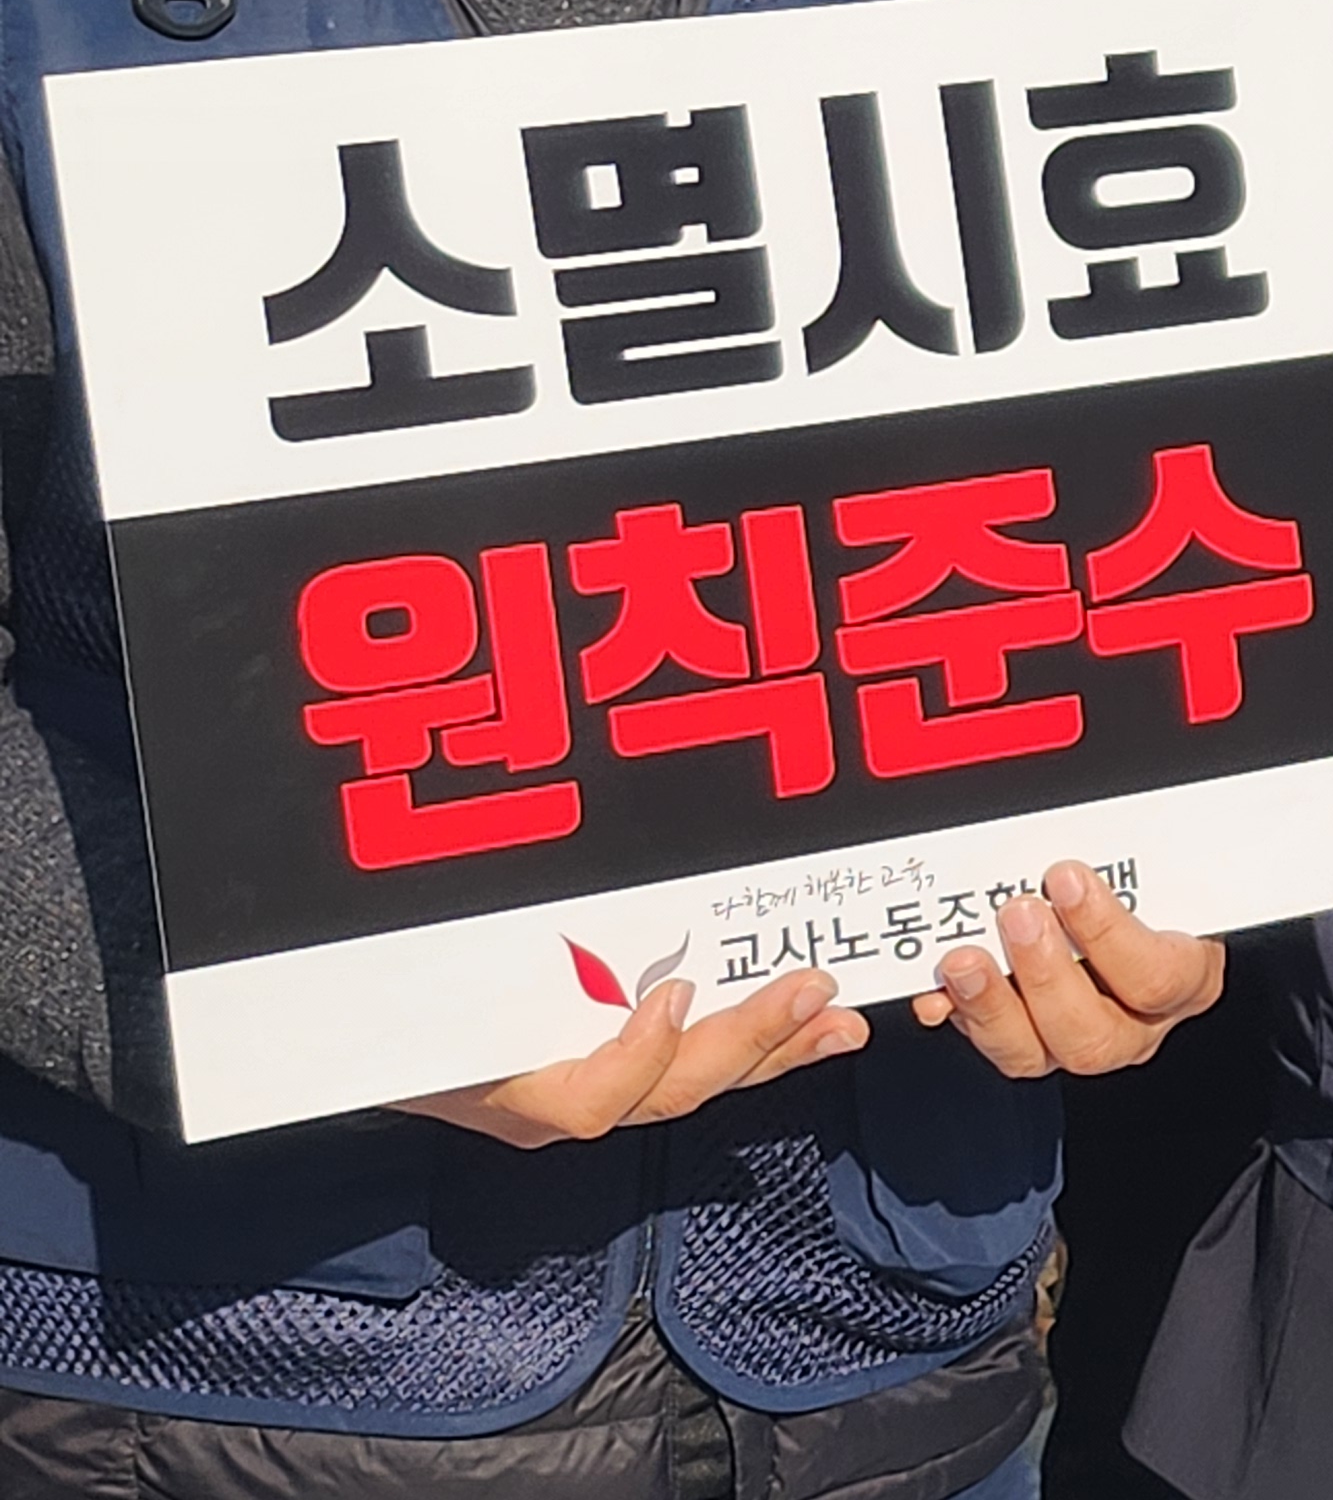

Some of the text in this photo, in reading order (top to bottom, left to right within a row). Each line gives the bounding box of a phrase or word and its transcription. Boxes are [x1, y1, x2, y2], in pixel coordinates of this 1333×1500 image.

[263, 49, 1271, 443] 소멸시효
[295, 442, 1316, 871] 원칙준수
[716, 857, 1140, 986] 교사노동조맹
